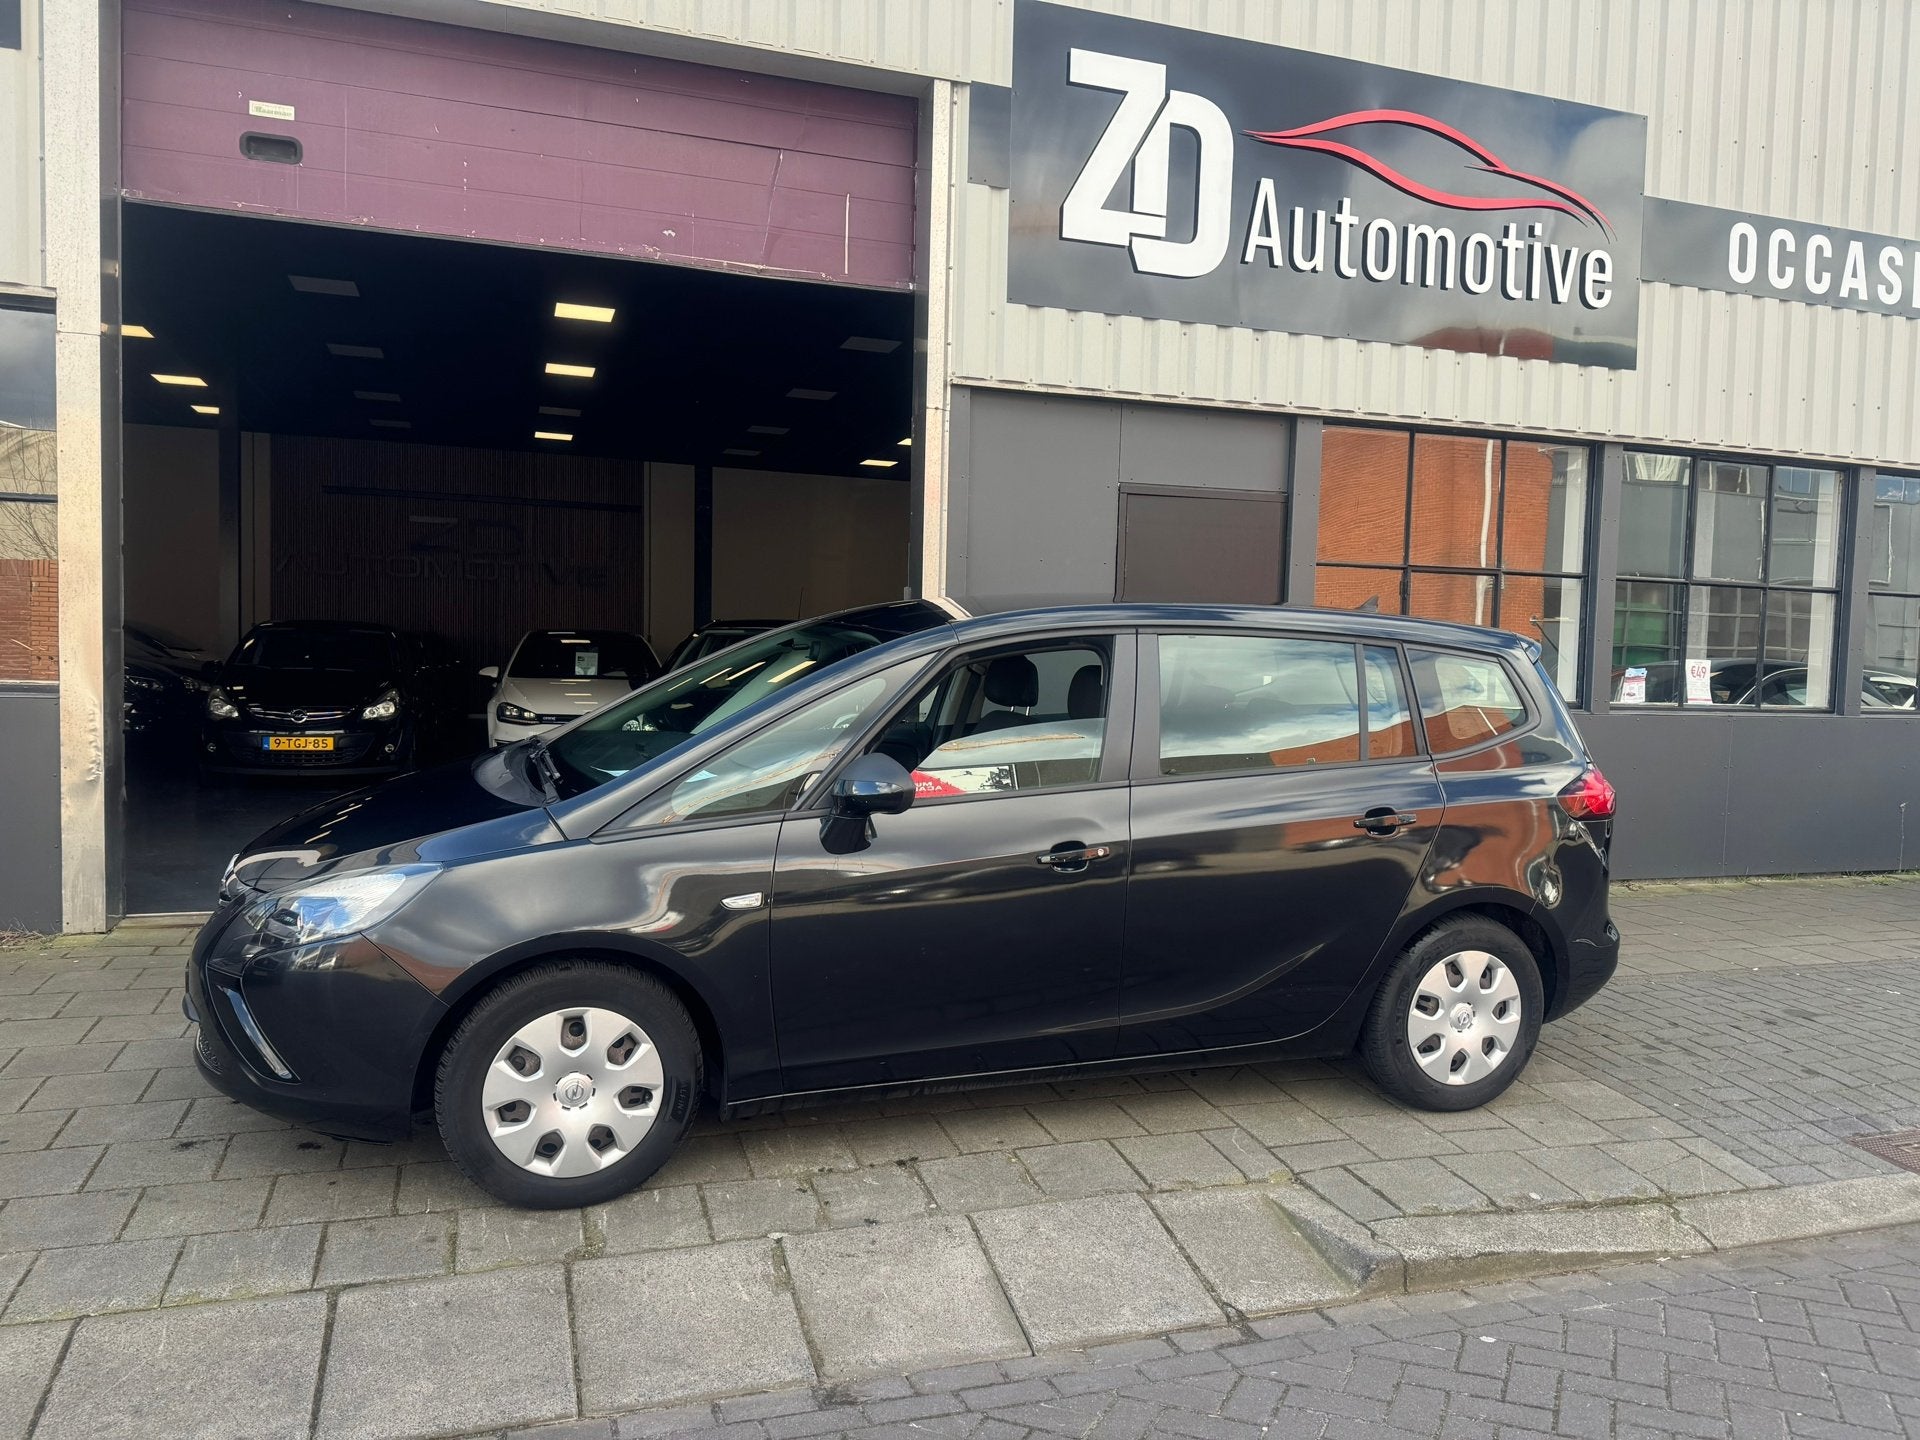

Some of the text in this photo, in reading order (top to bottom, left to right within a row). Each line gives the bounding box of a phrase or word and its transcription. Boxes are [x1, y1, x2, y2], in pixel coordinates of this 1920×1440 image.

[1060, 47, 1234, 278] ZD
[1243, 177, 1613, 309] Automotive
[1728, 221, 1920, 309] OCCASI
[1690, 665, 1707, 679] €49
[274, 738, 328, 749] 9-TGJ-85
